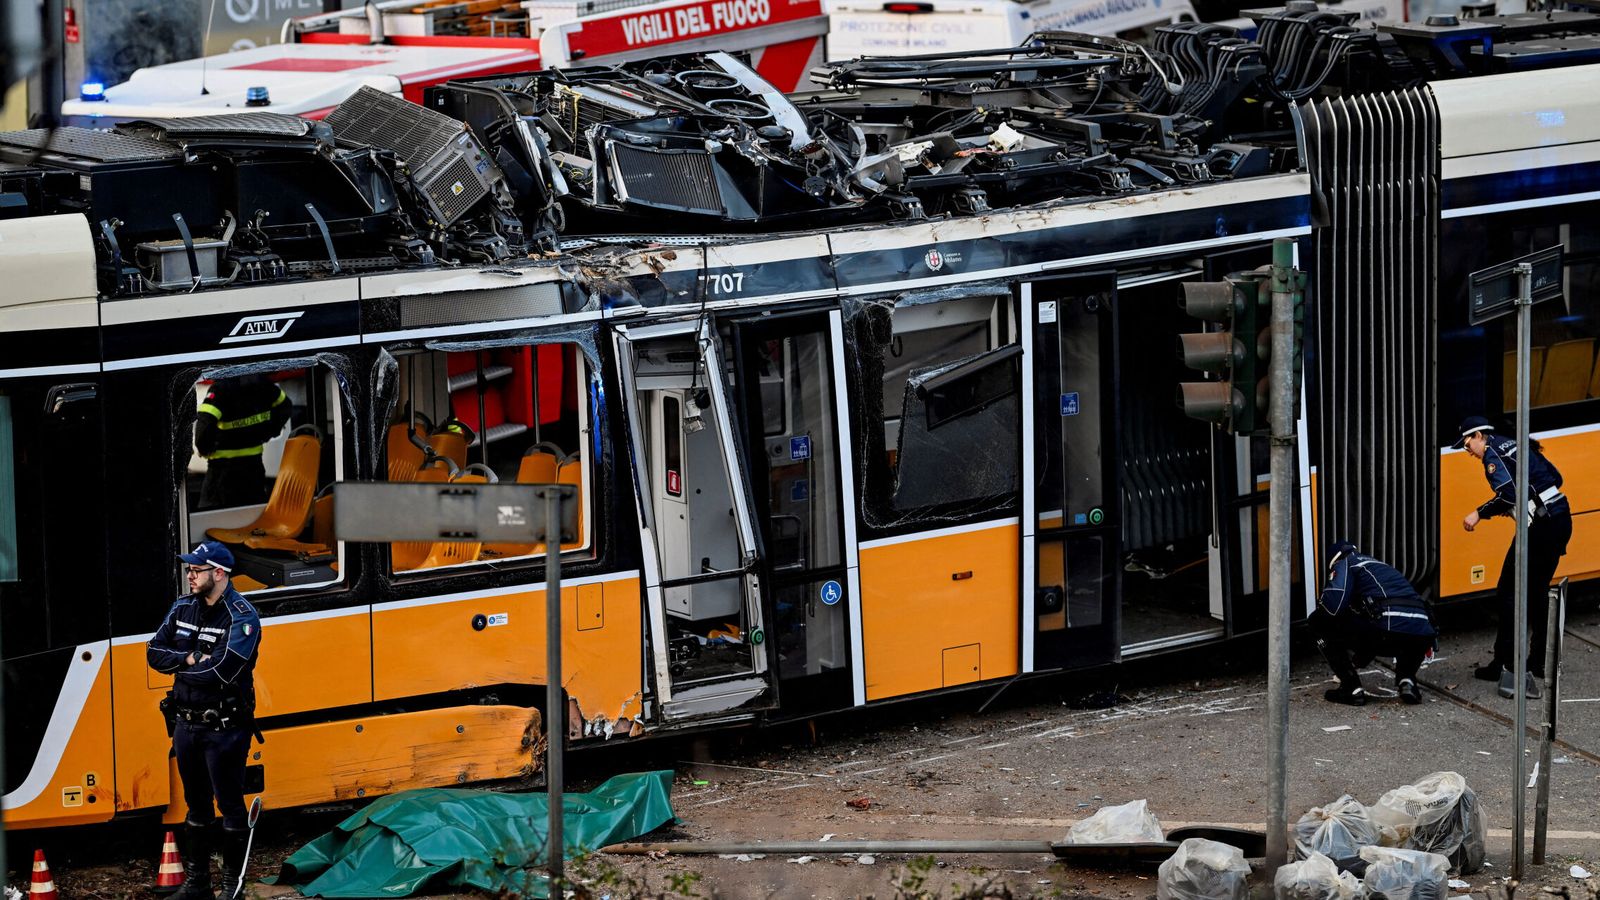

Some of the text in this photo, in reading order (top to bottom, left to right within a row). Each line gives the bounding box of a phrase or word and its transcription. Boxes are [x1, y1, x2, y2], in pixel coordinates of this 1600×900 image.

[621, 0, 771, 46] VIGILI DEL FUOCO
[840, 21, 976, 34] PROTEZIONE CIVILE
[862, 39, 899, 47] COMUNE
[913, 39, 947, 47] MILANO
[698, 272, 743, 294] 7707
[245, 320, 278, 335] ATM
[87, 774, 95, 786] B
